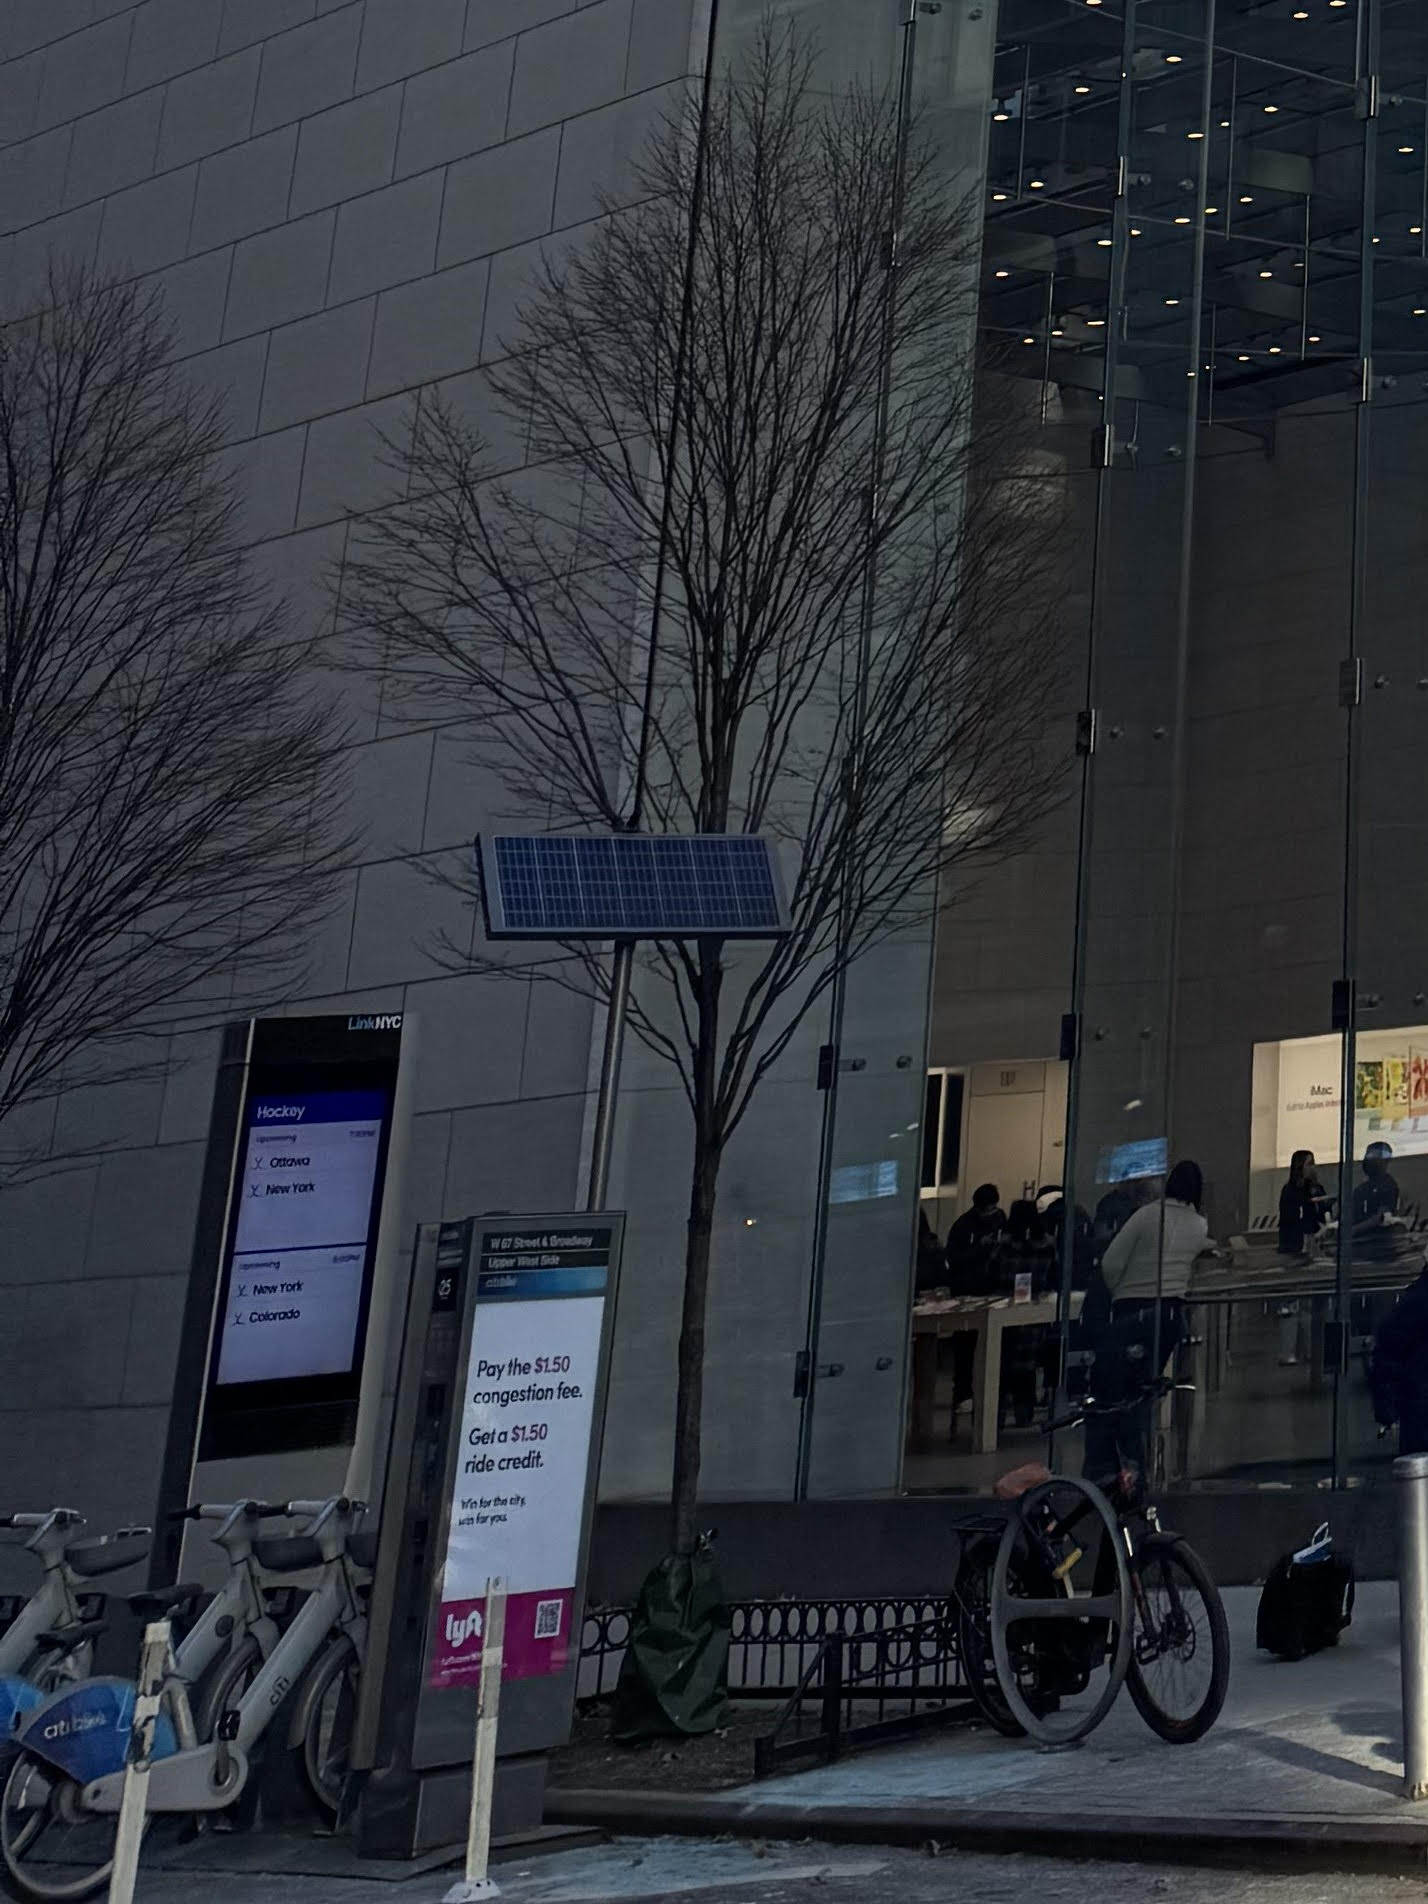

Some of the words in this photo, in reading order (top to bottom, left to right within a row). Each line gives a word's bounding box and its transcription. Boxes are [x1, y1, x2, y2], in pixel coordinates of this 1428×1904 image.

[348, 1016, 402, 1031] LinkNYC
[257, 1105, 306, 1121] Hockey
[270, 1156, 311, 1169] Ottawa
[266, 1184, 290, 1196] New
[292, 1182, 316, 1194] York
[253, 1284, 278, 1297] New
[280, 1281, 304, 1293] York
[249, 1308, 301, 1324] Colorado
[477, 1359, 506, 1381] Pay
[507, 1357, 532, 1377] the
[534, 1355, 571, 1375] $1.50
[473, 1383, 554, 1408] congestion
[556, 1381, 583, 1400] fee.
[469, 1427, 496, 1446] Get
[497, 1430, 508, 1443] a
[511, 1423, 549, 1443] $1.50
[465, 1454, 495, 1474] ride
[498, 1450, 545, 1471] credit.
[445, 1610, 483, 1648] lyft
